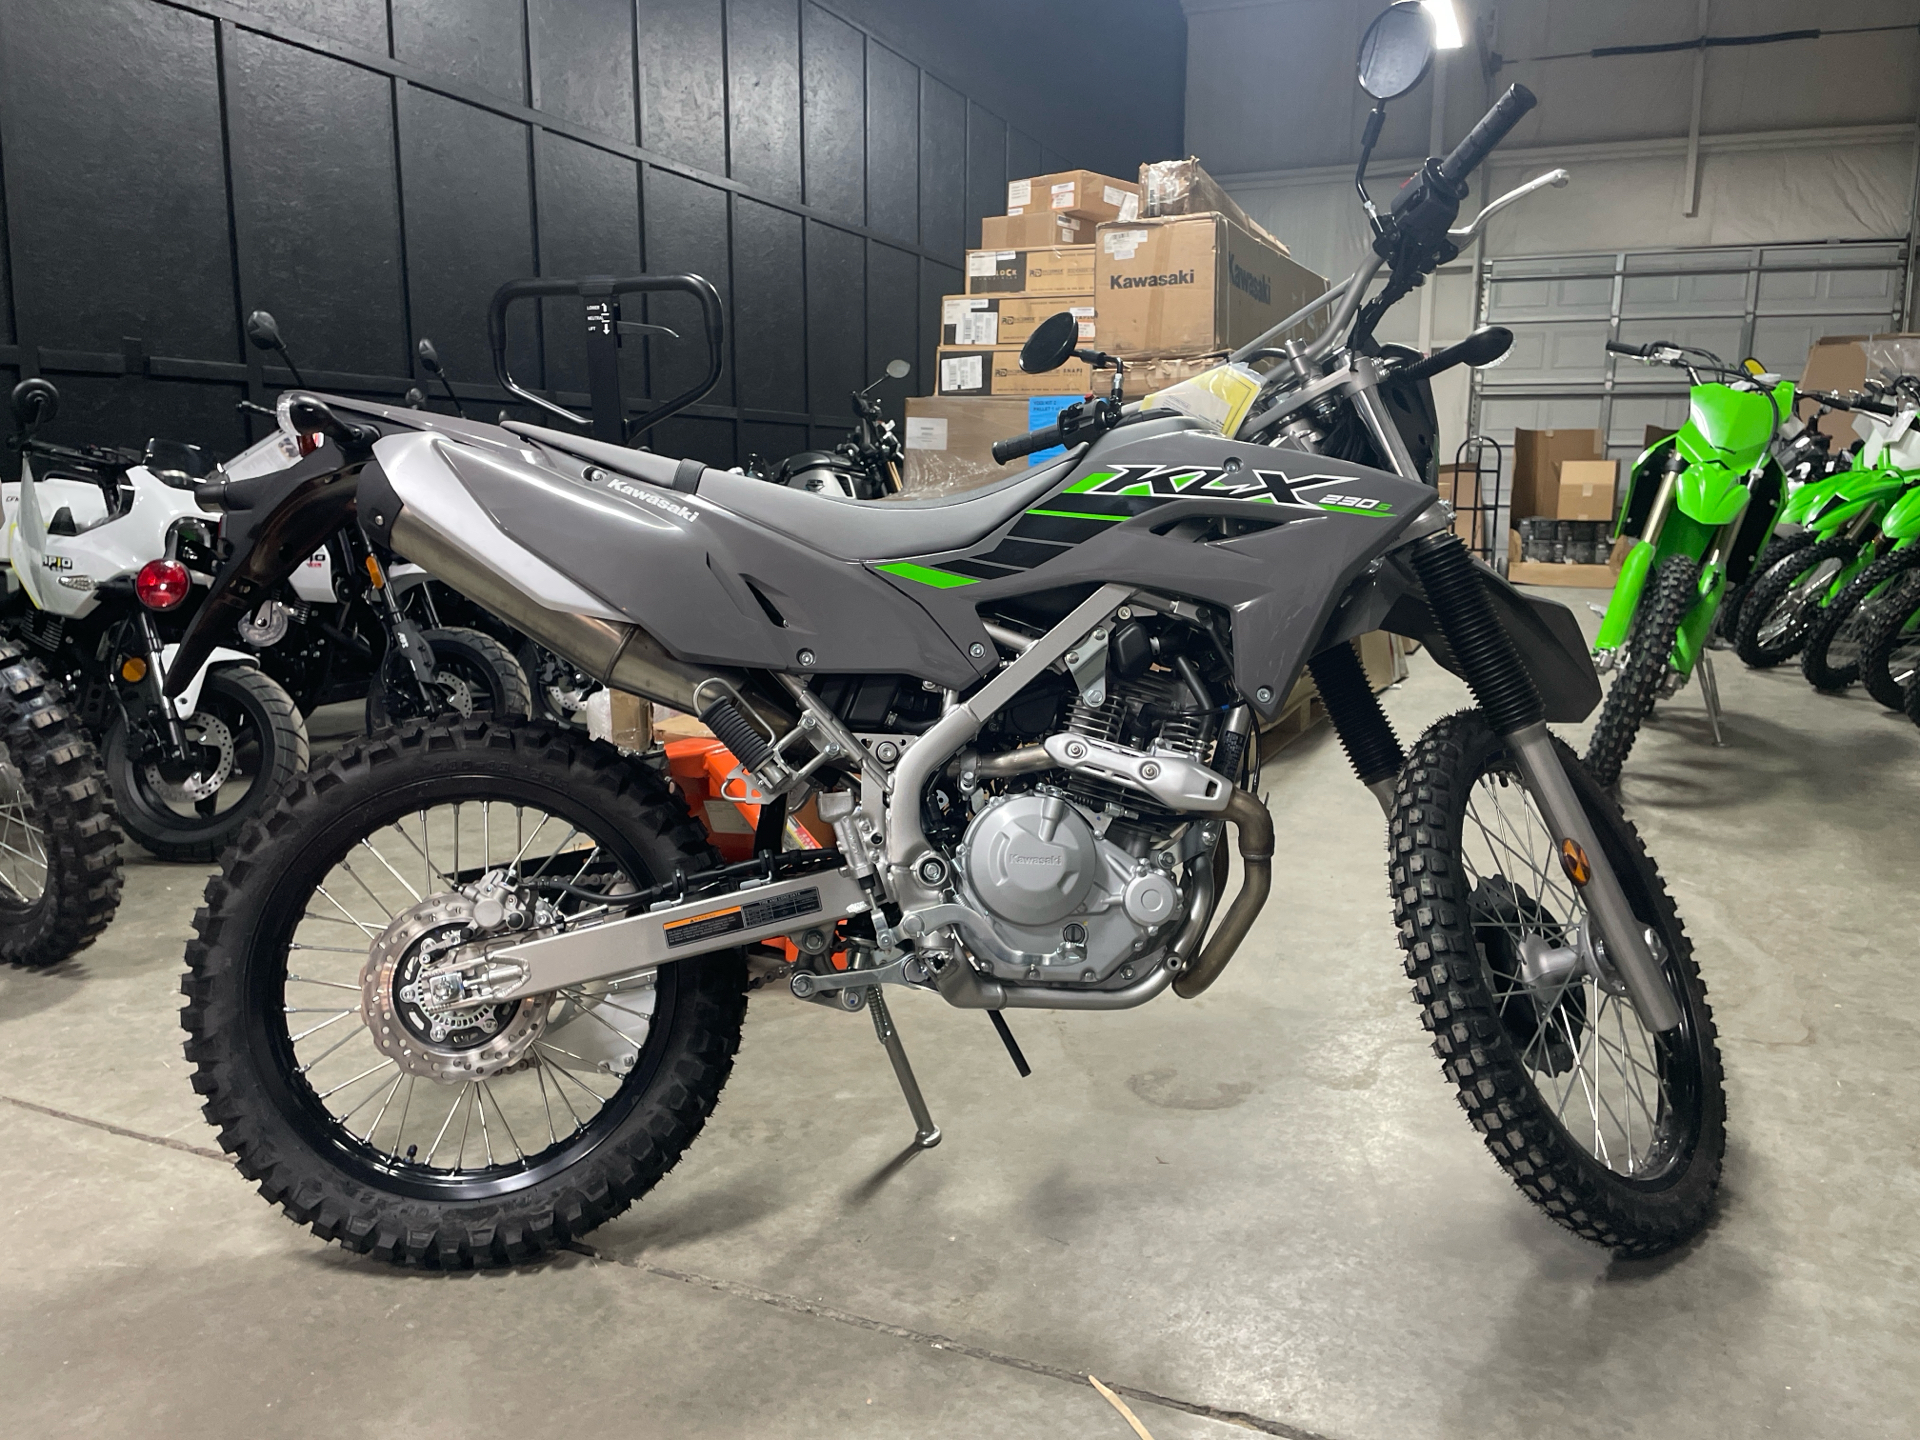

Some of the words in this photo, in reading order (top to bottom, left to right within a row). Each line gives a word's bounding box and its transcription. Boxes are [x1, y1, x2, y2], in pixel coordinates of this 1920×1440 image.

[1110, 269, 1195, 290] Kawasaki
[1228, 252, 1271, 305] Kawasaki
[607, 478, 699, 523] Kawasaki
[1083, 464, 1361, 511] KLX
[1009, 853, 1063, 866] Kawasaki
